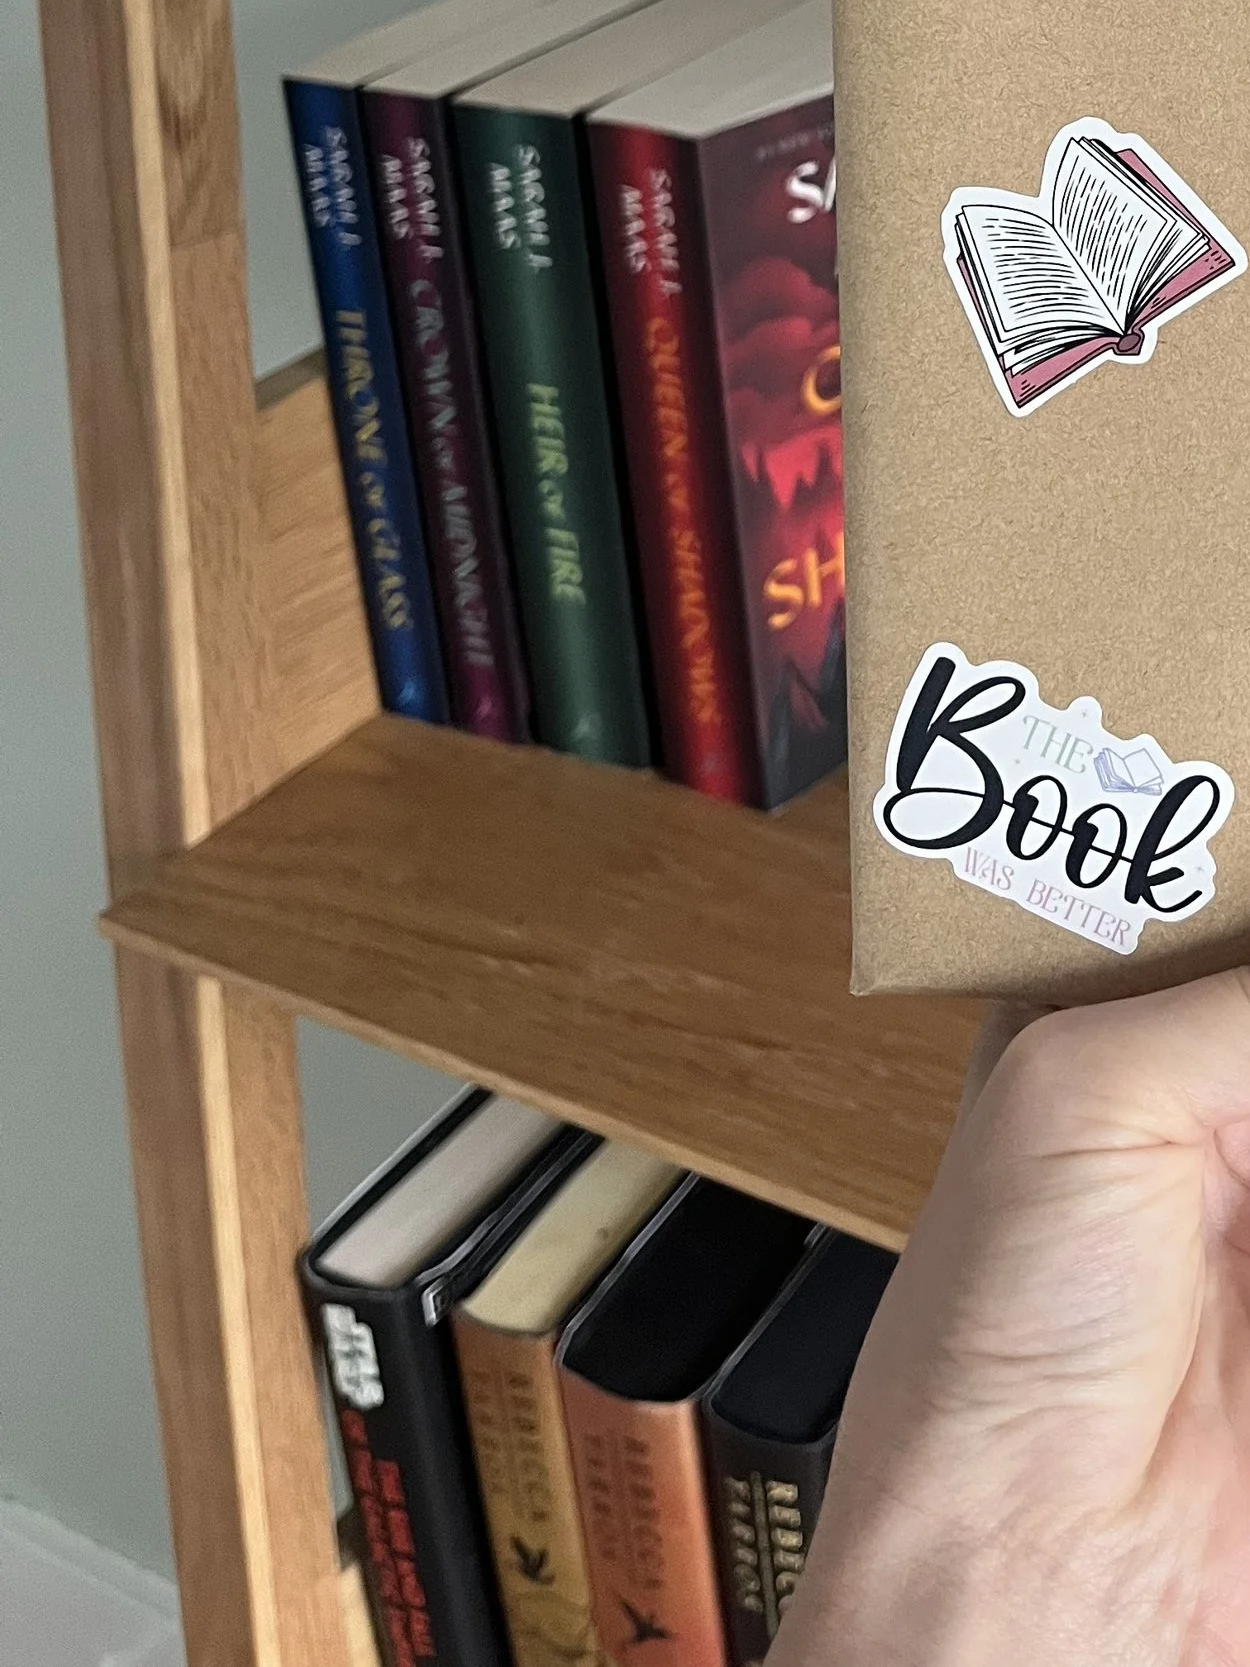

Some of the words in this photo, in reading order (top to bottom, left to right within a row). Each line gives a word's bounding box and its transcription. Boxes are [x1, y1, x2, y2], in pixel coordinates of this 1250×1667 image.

[527, 384, 568, 475] HEIR
[544, 527, 586, 605] FIRE
[883, 657, 1220, 912] Book
[1023, 714, 1093, 774] THE
[964, 846, 1015, 891] WAS
[1025, 878, 1131, 946] BETTER
